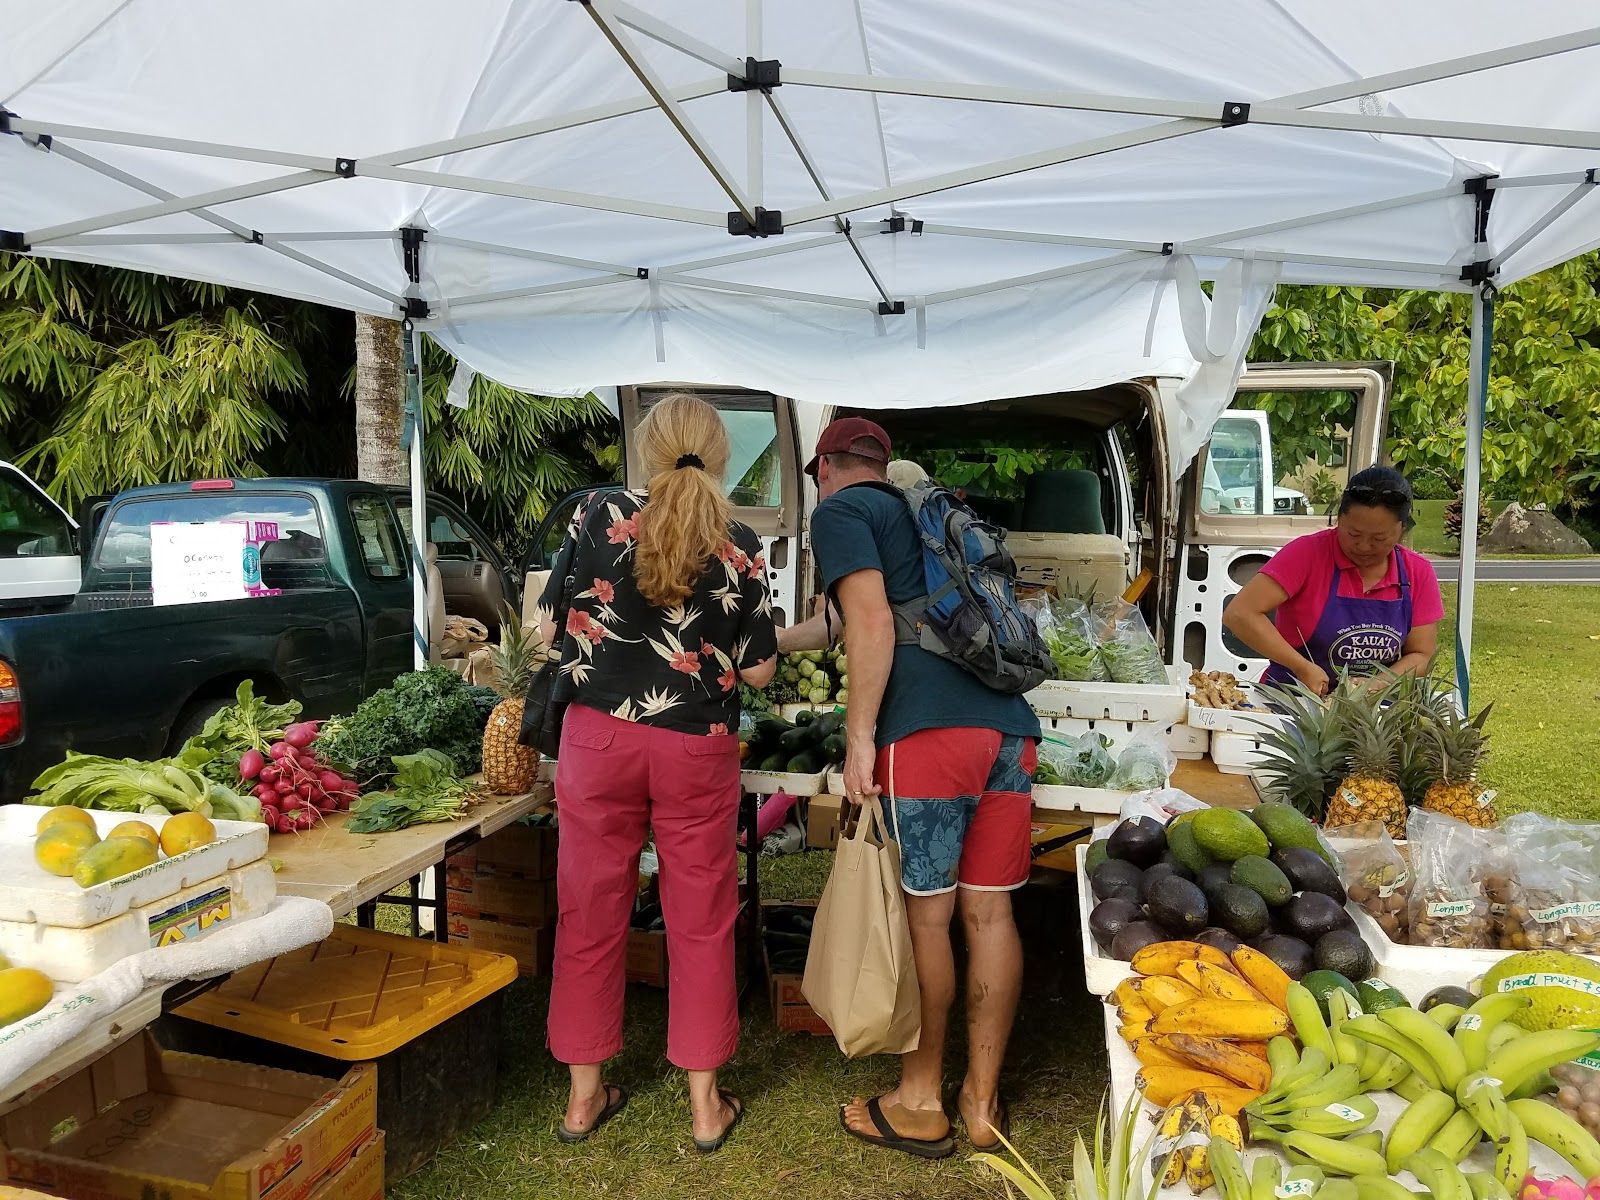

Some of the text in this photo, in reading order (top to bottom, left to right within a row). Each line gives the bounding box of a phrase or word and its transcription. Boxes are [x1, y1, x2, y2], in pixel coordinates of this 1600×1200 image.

[1337, 644, 1397, 661] GROWN
[1543, 974, 1579, 989] Fruit
[257, 1142, 304, 1194] Dole
